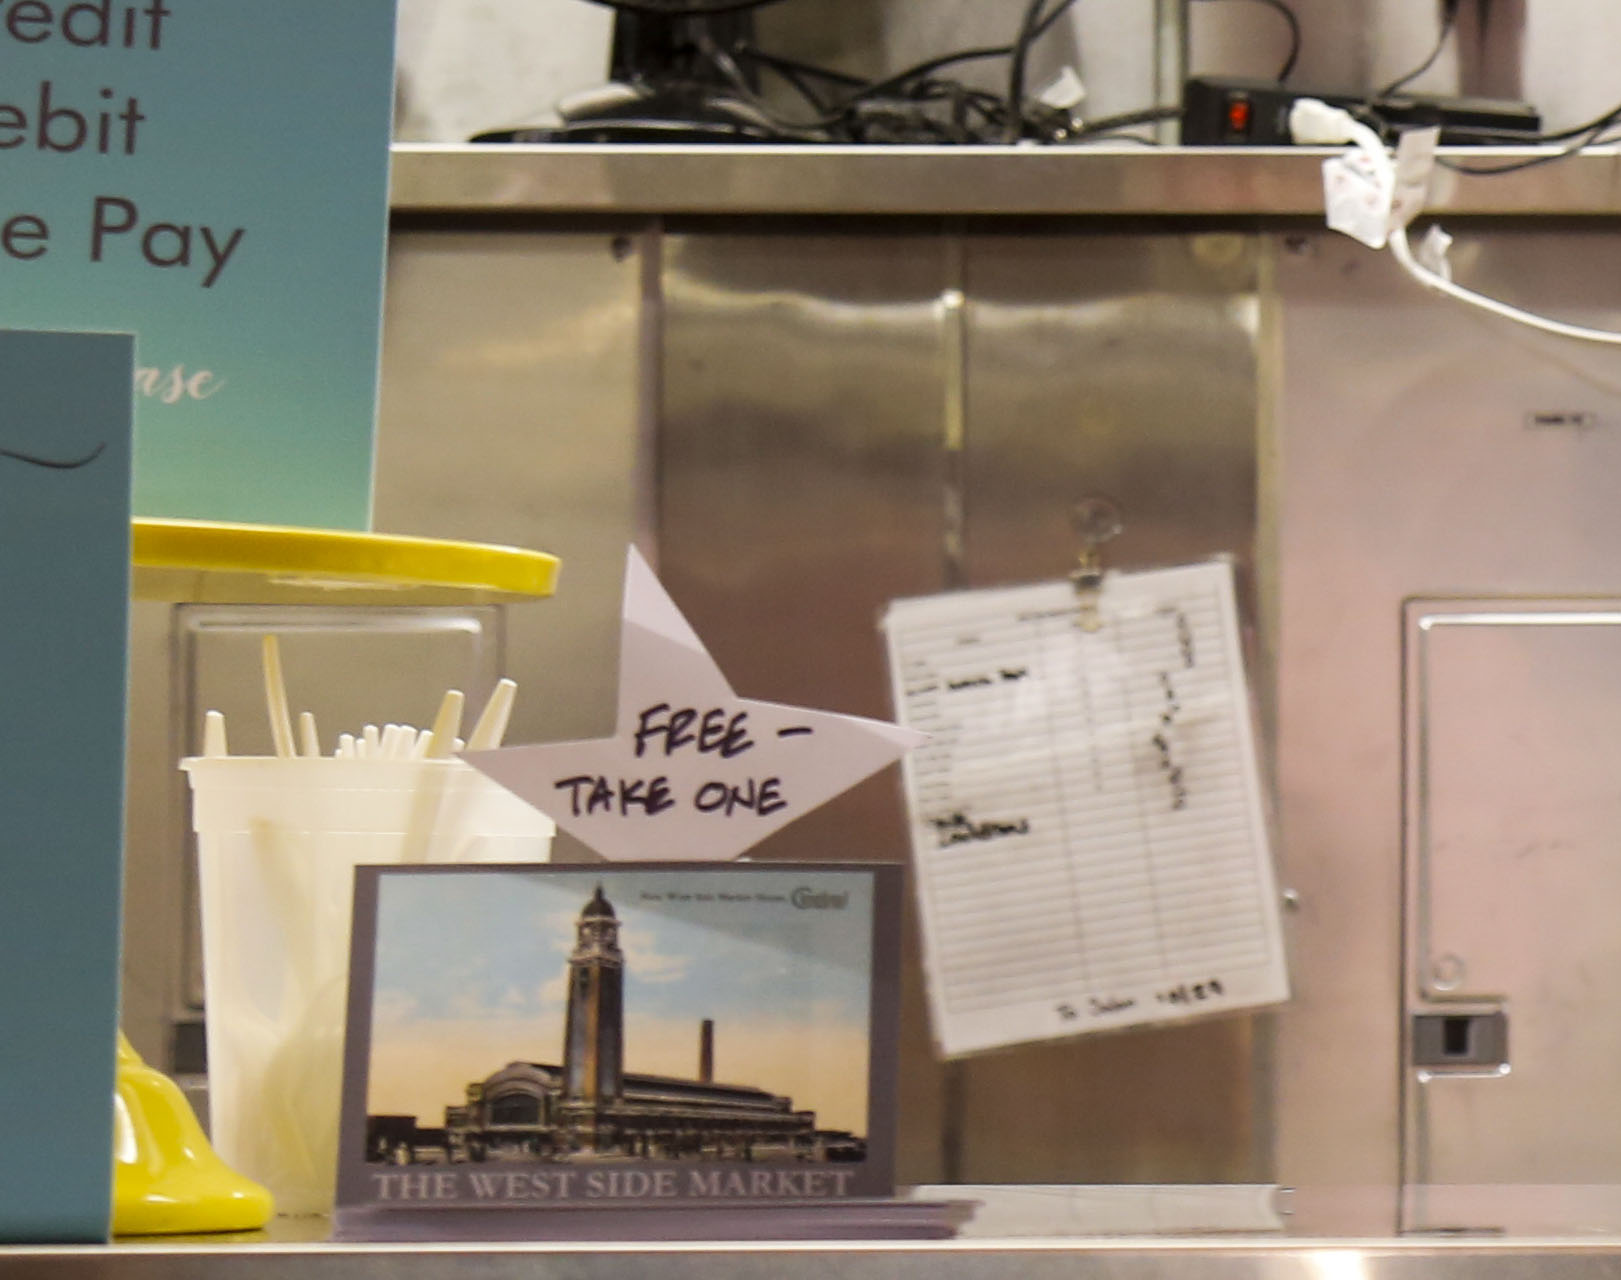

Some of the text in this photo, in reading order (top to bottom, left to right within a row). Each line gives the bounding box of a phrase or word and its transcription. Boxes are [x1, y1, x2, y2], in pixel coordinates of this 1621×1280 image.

[90, 195, 245, 288] Pay
[633, 703, 754, 758] FREE
[554, 775, 788, 817] TAKE ONE
[372, 1169, 856, 1201] THE WEST SIDE MARKET
